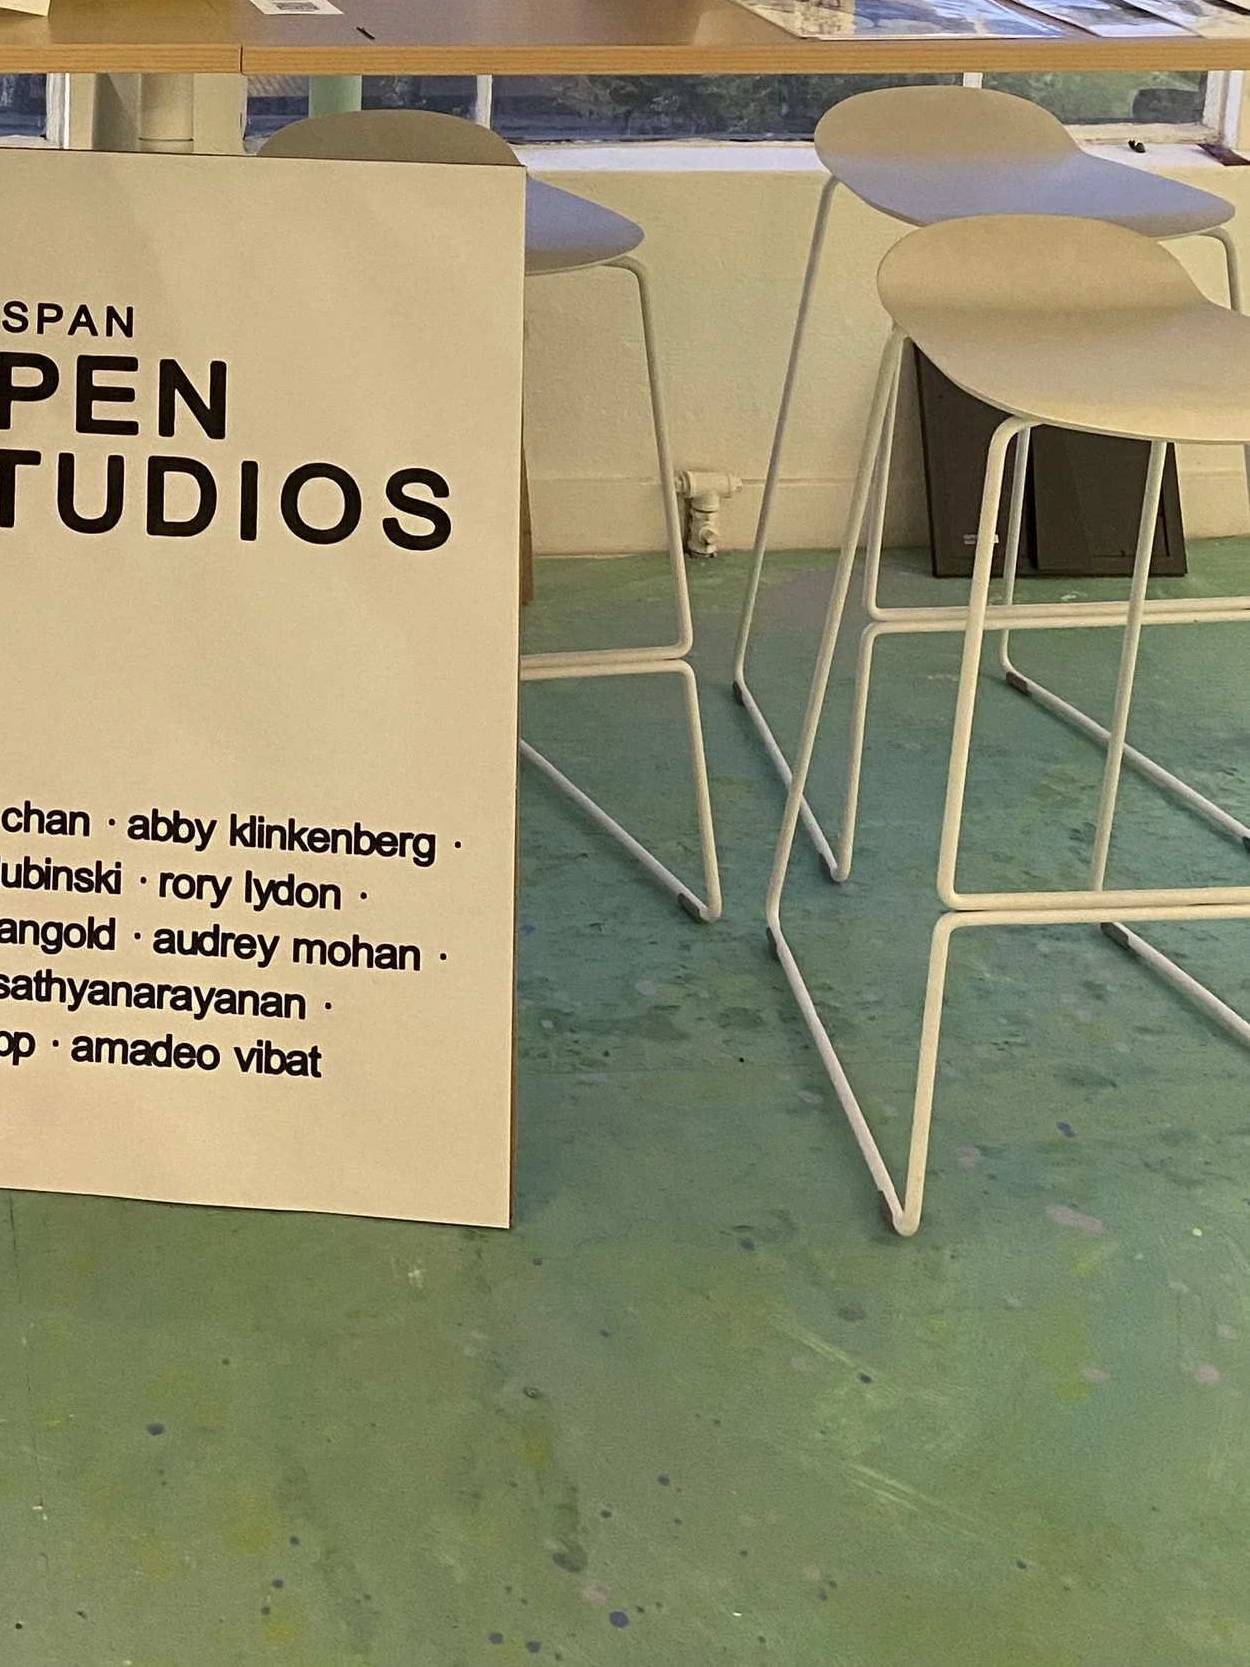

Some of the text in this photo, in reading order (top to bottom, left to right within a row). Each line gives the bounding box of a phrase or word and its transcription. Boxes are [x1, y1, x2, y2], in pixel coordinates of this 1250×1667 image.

[1, 799, 90, 837] chan
[127, 808, 218, 852] abby
[229, 813, 436, 868] klinkenberg
[159, 872, 233, 909] rory
[244, 869, 342, 911] lydon
[152, 923, 281, 969] audrey
[292, 934, 421, 972] mohan
[70, 1033, 221, 1071] amadeo
[233, 1039, 322, 1078] vibat
